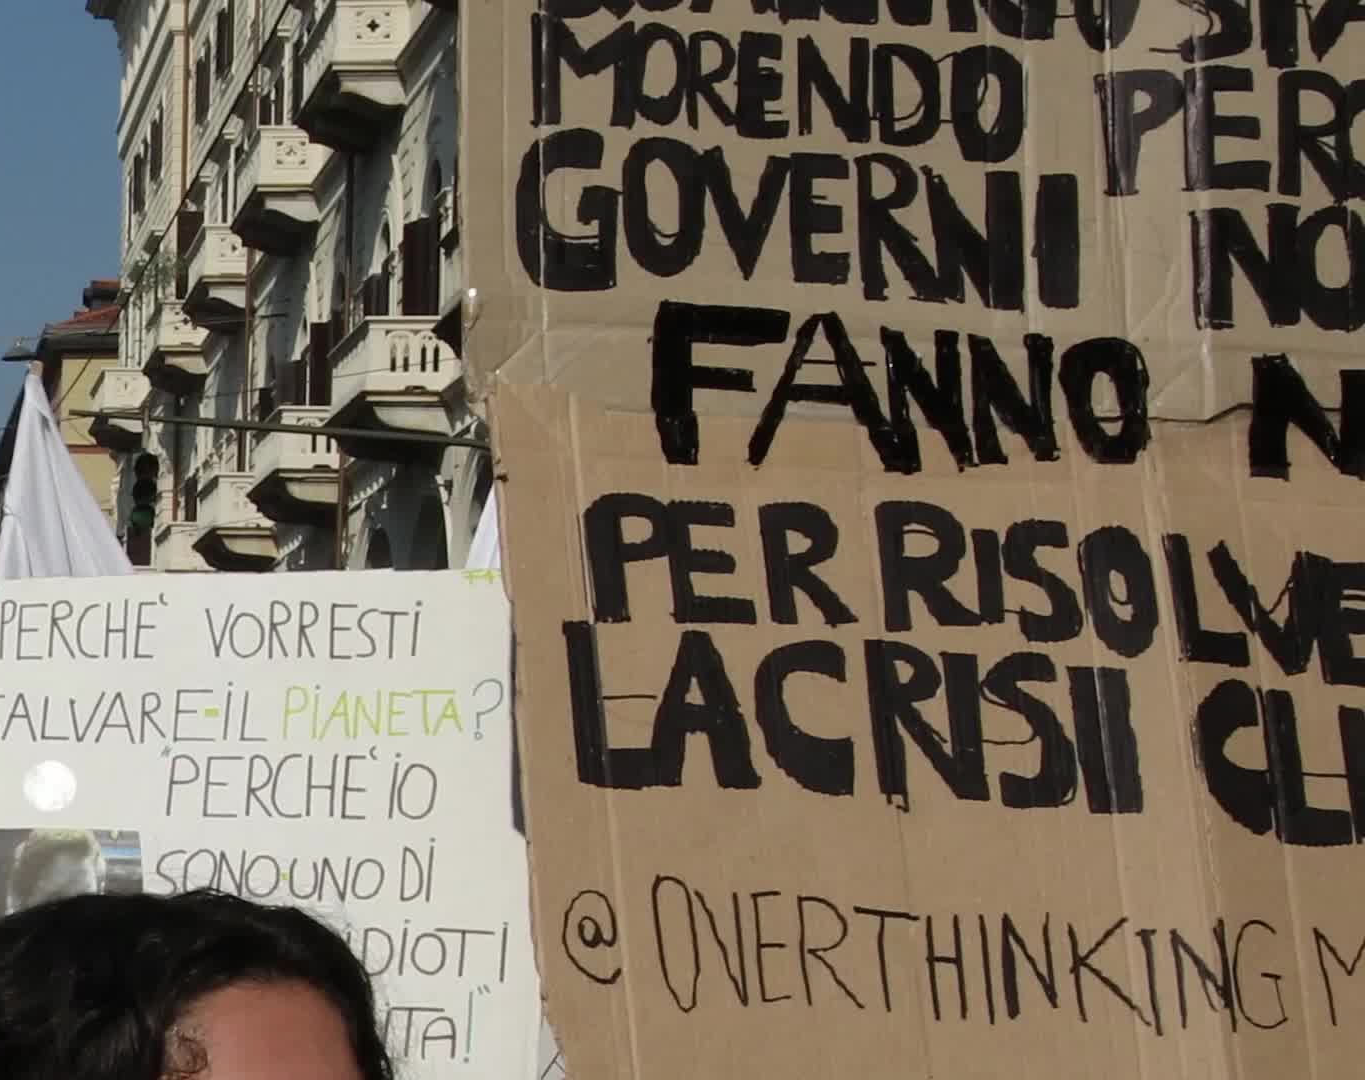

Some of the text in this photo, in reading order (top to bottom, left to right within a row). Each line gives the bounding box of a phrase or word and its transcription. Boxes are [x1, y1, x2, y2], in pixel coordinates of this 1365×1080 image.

[531, 13, 1365, 205] MORENDO PER
[516, 128, 1080, 313] GOVERNI
[651, 300, 1148, 475] FANNO
[584, 491, 860, 626] PER
